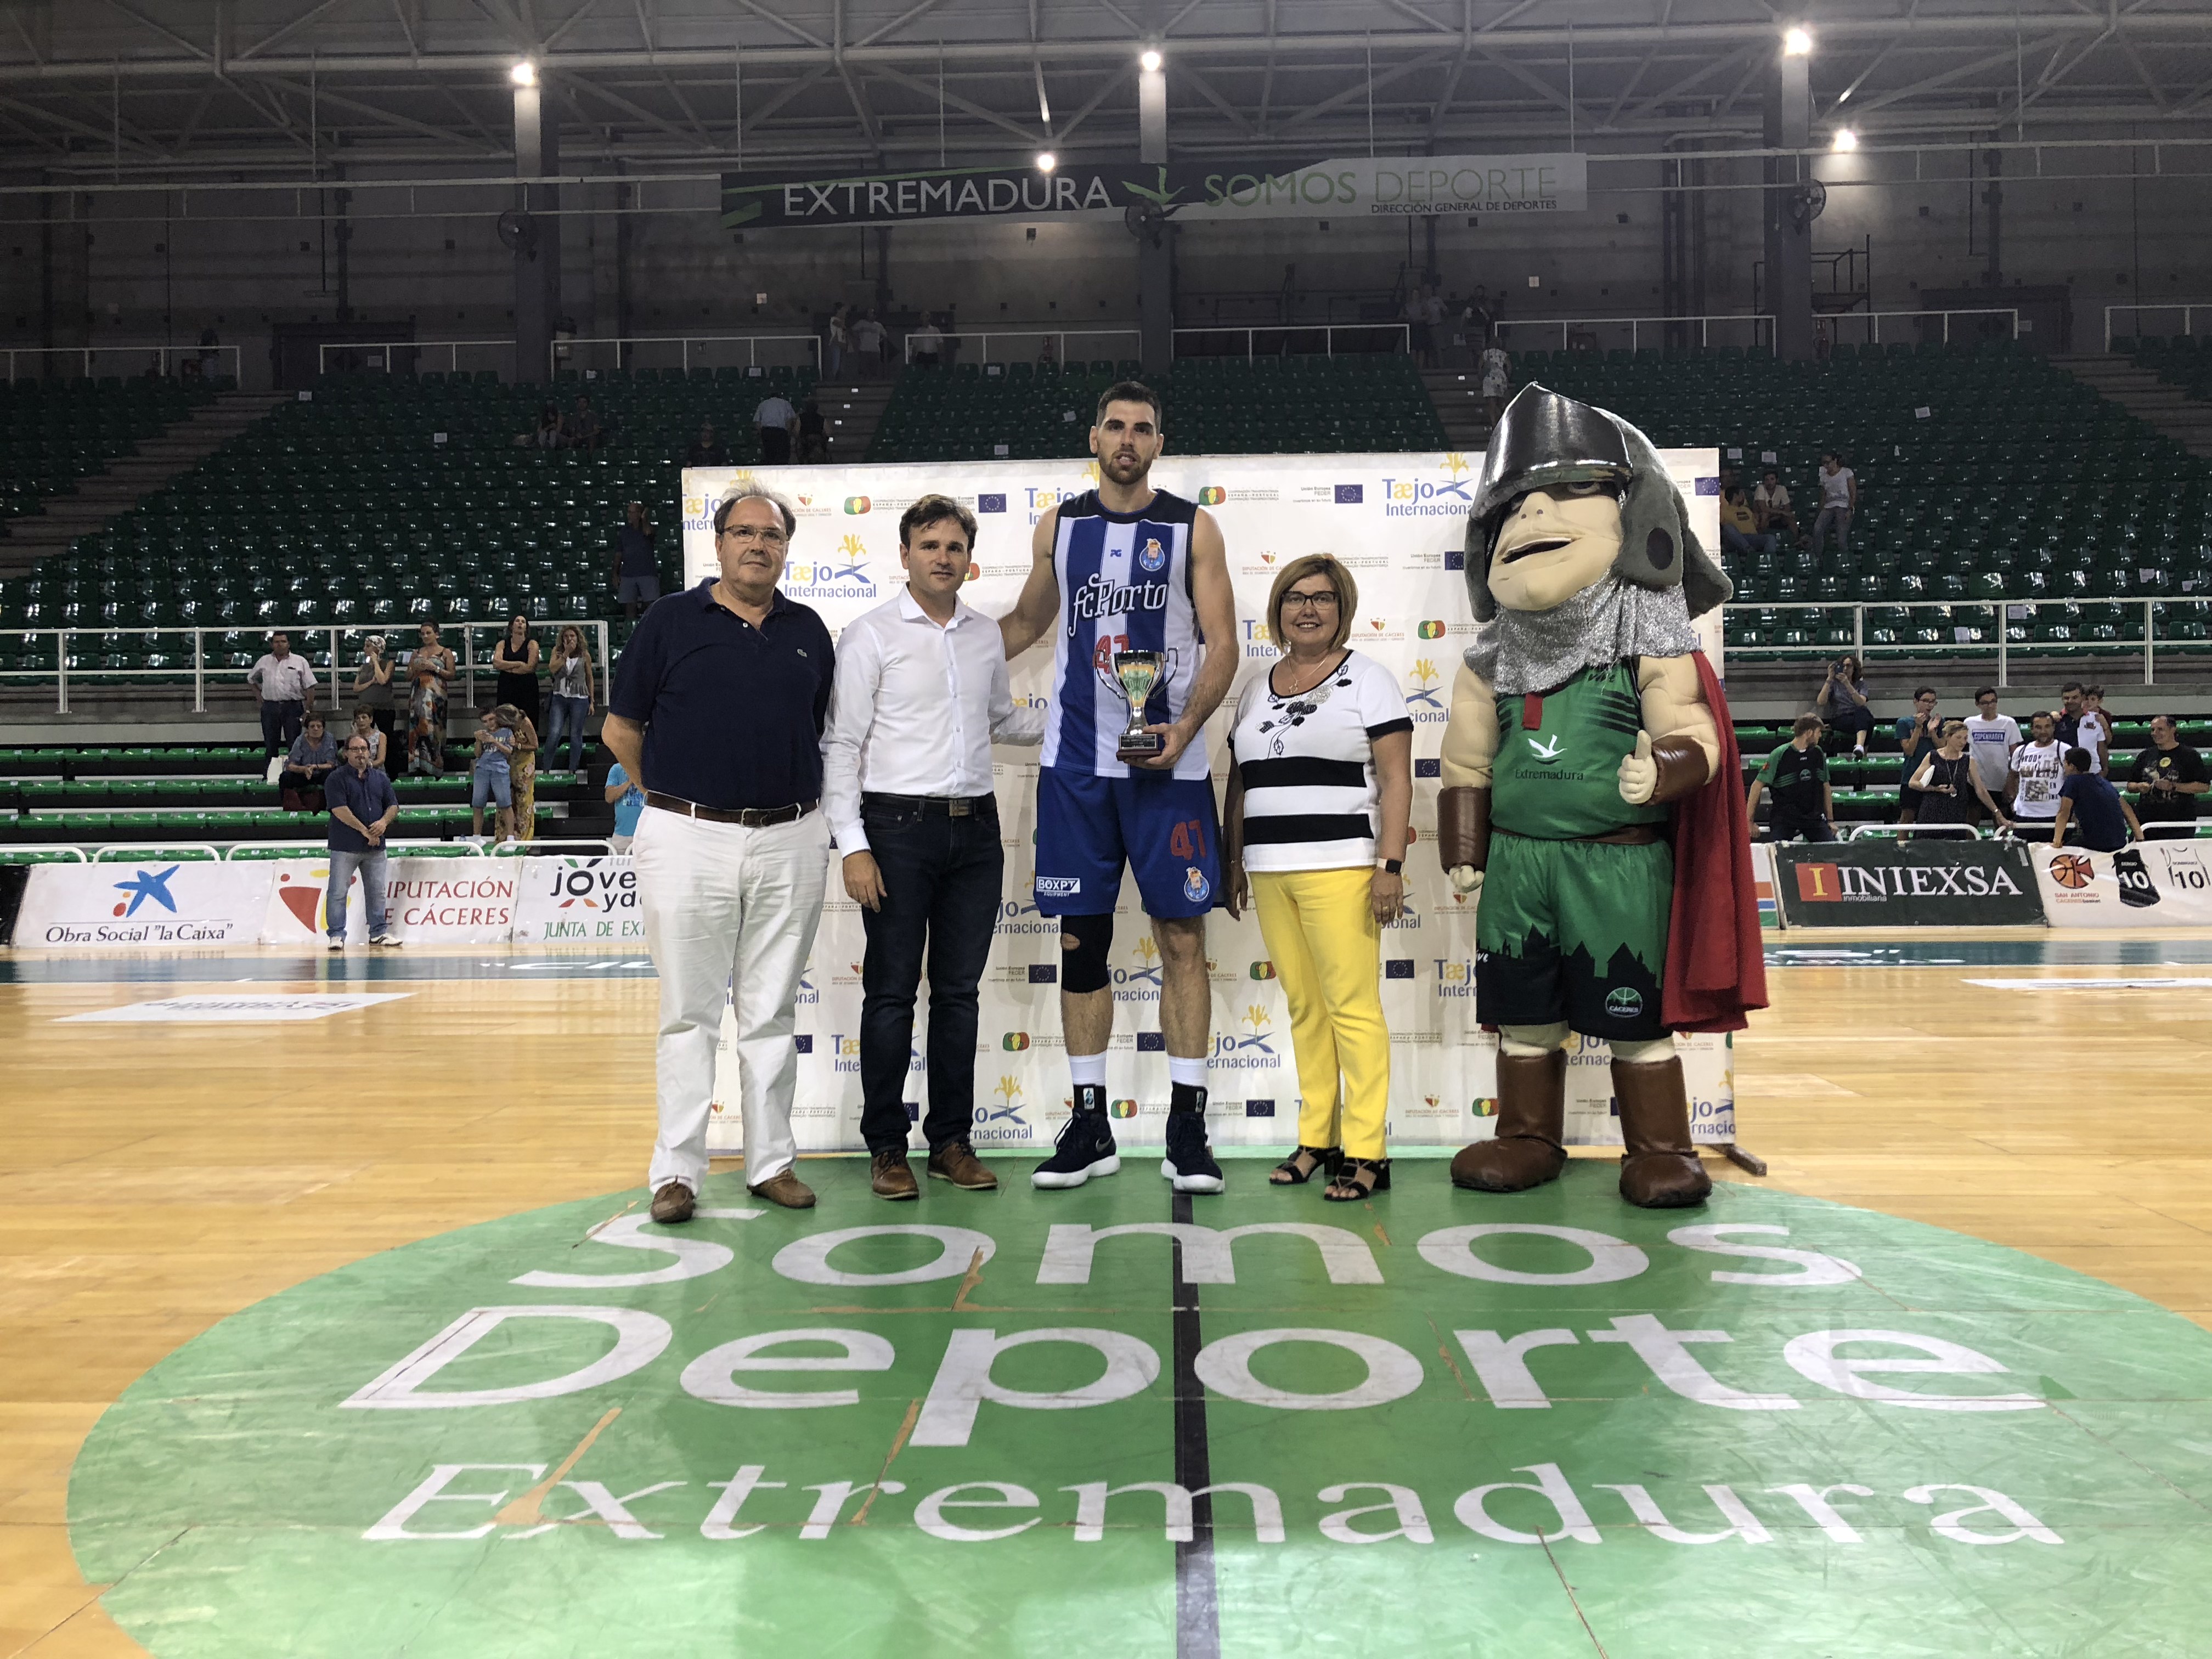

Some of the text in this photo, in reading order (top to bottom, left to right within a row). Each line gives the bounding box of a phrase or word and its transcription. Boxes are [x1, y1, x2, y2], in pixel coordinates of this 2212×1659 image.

[784, 176, 1113, 216] EXTREMADURA
[1204, 167, 1557, 207] SOMOS DEPORTE
[1372, 199, 1557, 214] DIRECCIÓN GENERAL DE DEPORTES
[682, 493, 724, 520] æjo
[785, 583, 876, 598] Internacional
[1515, 769, 1584, 780] Extremadura
[387, 876, 513, 899] IPUTACIÓN
[1038, 879, 1075, 891] BOXPT
[1838, 865, 2023, 896] INIEXSA
[2119, 871, 2149, 889] 10
[2175, 870, 2205, 889] 10
[404, 903, 509, 926] CÁCERES
[46, 926, 91, 943] Obra
[97, 924, 149, 942] Social
[543, 921, 586, 940] JUNTA
[596, 921, 614, 936] DE
[831, 1034, 860, 1055] Tæ
[1207, 1053, 1281, 1069] ernacional
[508, 1208, 1862, 1287] Somos
[336, 1306, 2046, 1447] Deporte
[360, 1462, 2065, 1545] Extremadura
